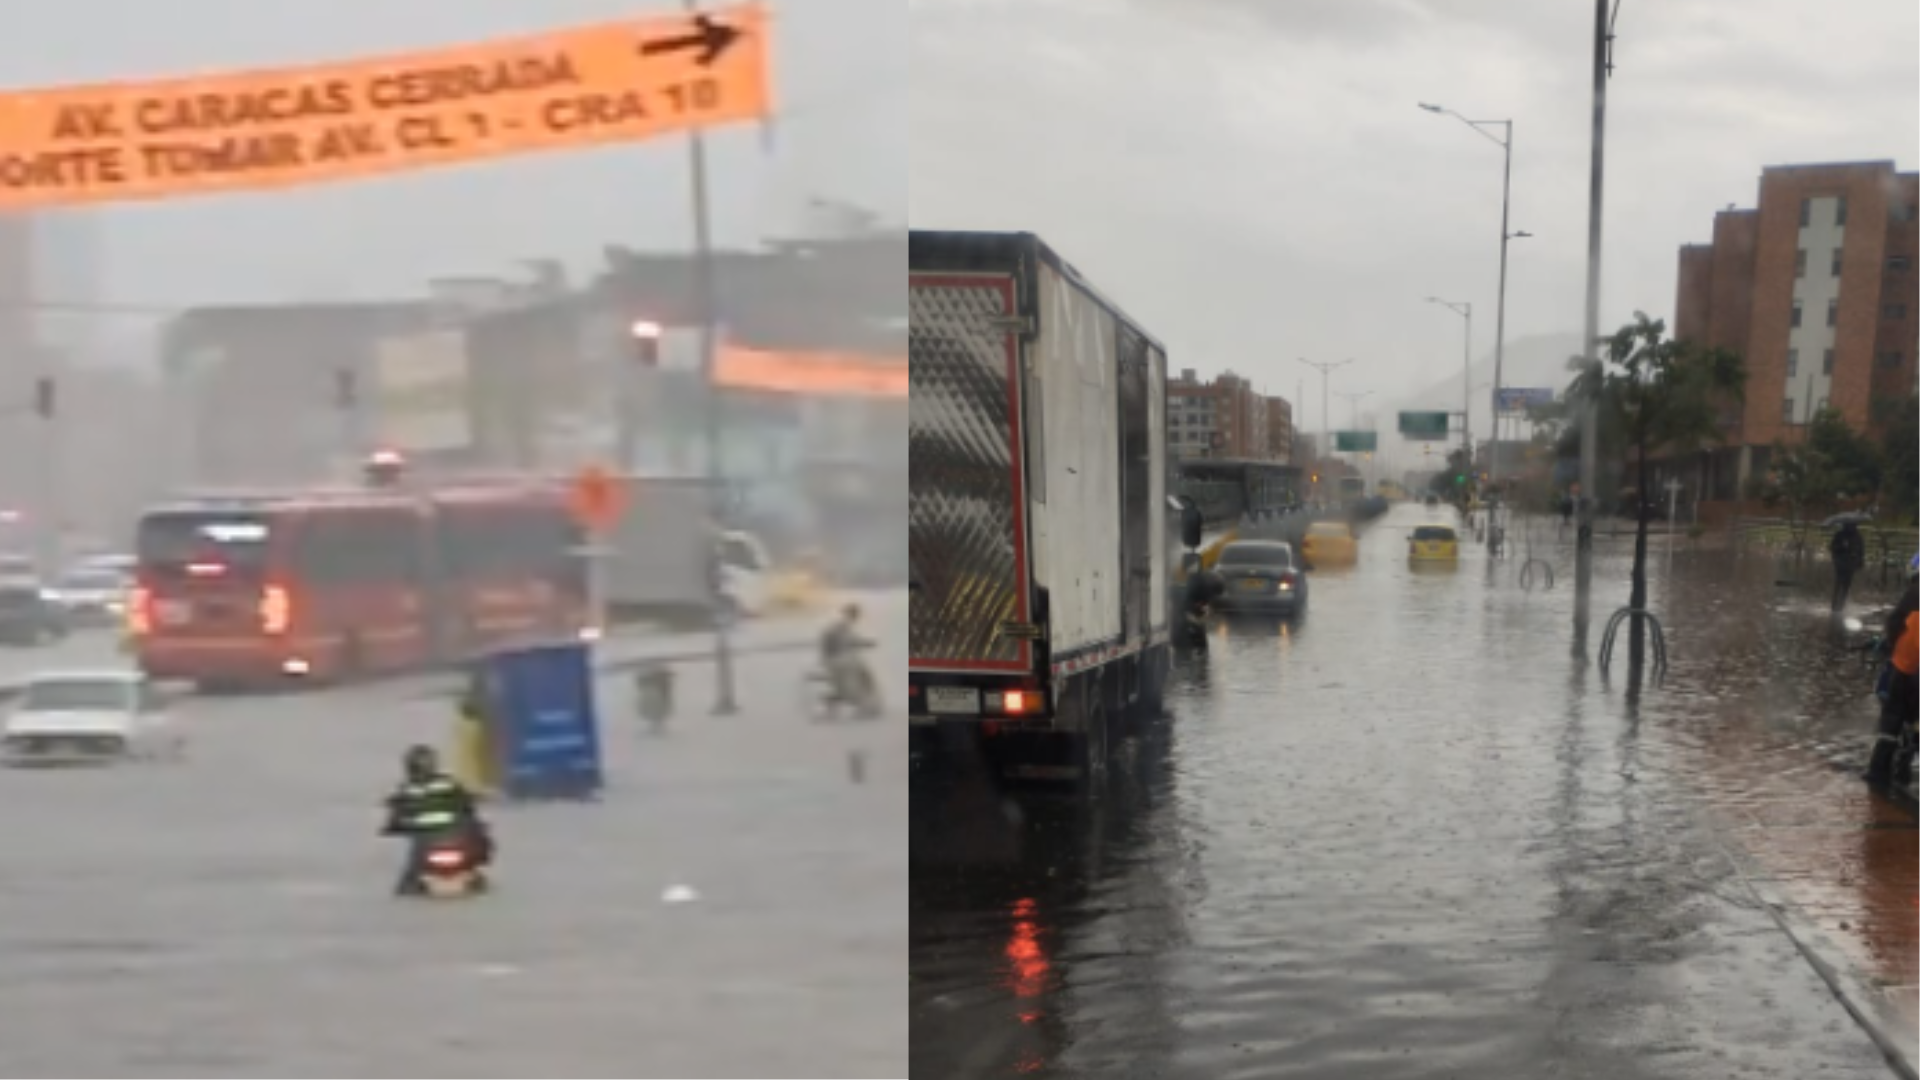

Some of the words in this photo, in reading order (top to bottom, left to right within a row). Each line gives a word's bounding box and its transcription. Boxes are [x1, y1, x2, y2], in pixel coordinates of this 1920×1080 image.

[137, 82, 351, 134] CARACAS
[369, 54, 580, 108] CERRADA
[140, 132, 304, 178] TOMAR
[398, 116, 455, 149] CL
[544, 92, 651, 132] CRA
